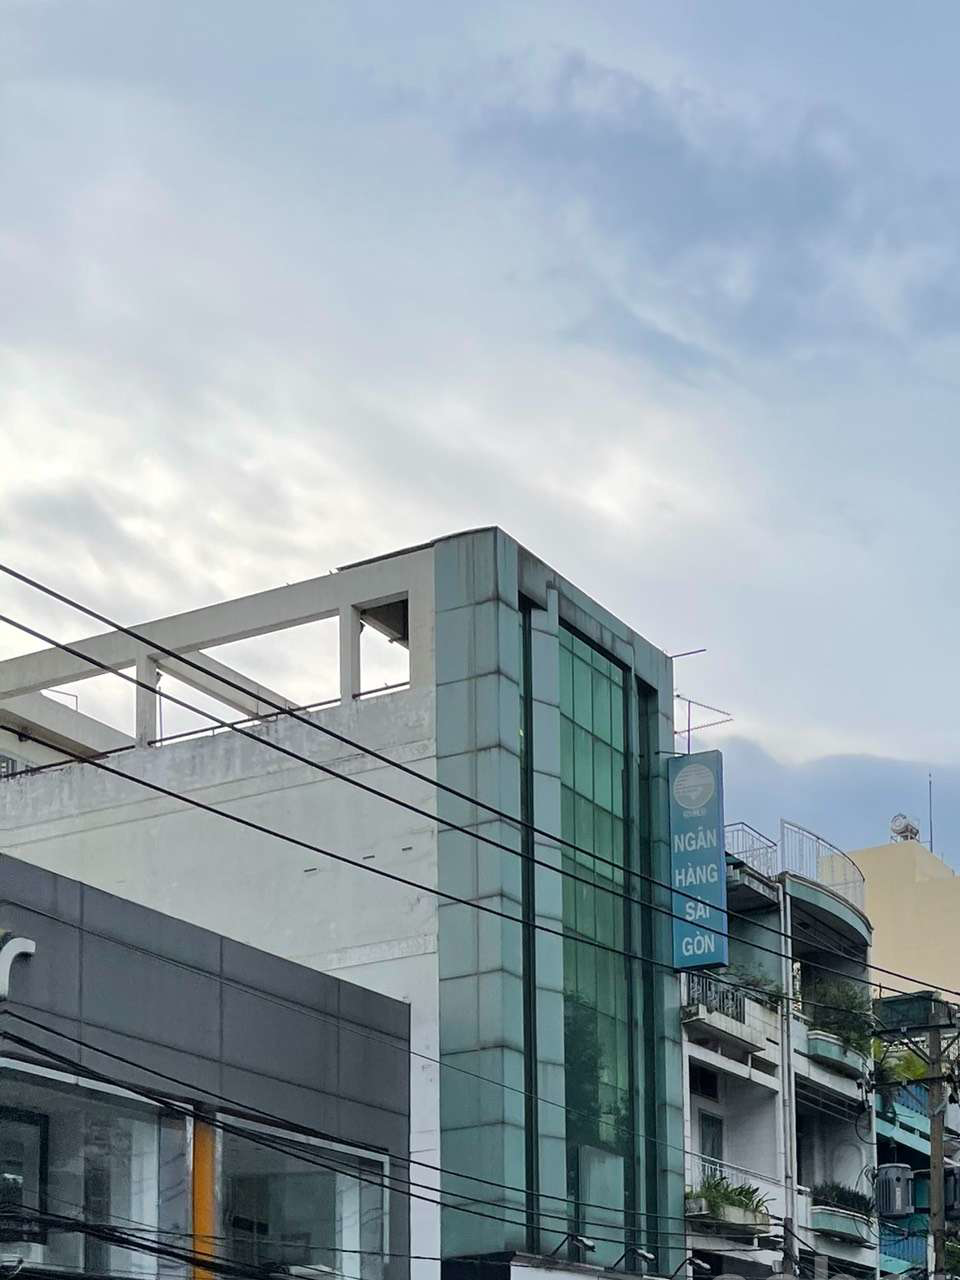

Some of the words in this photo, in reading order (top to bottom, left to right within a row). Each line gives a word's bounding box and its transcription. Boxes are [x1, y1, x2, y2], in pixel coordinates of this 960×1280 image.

[674, 827, 717, 853] NGÂN
[674, 862, 718, 887] HÀNG
[682, 931, 715, 956] GÒN
